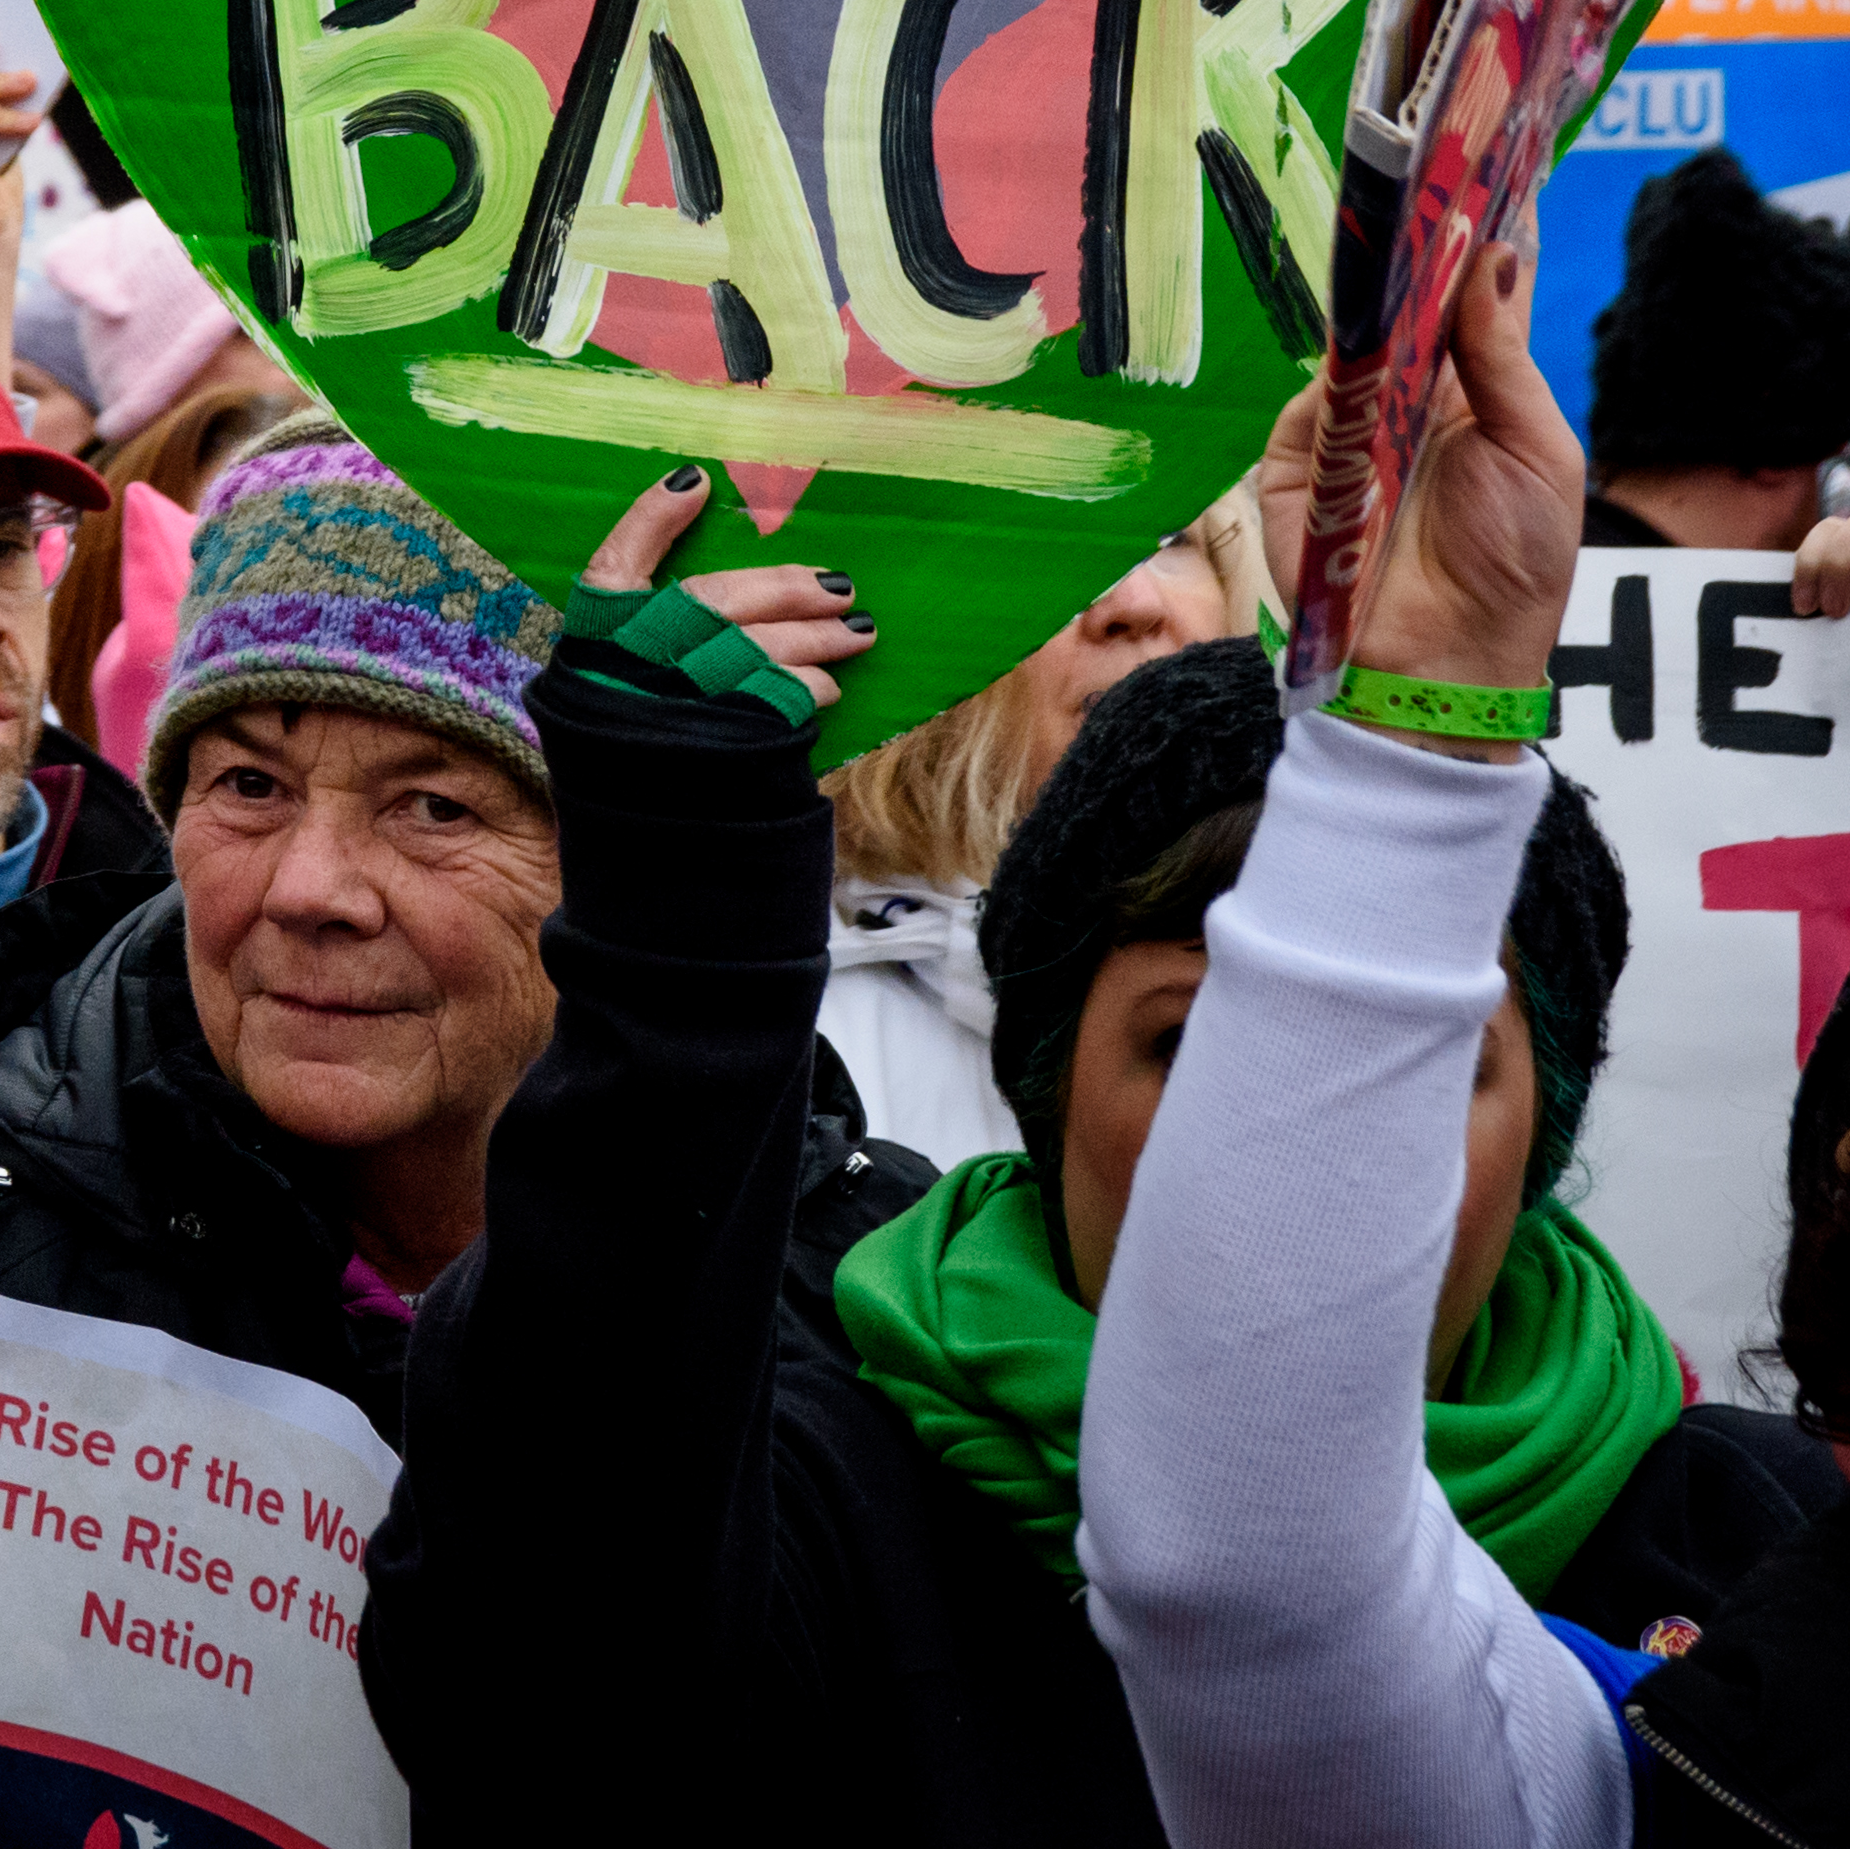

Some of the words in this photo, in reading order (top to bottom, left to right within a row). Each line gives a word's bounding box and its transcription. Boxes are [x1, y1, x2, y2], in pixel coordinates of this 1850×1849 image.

[135, 1440, 193, 1490] of
[206, 1457, 286, 1524] the
[122, 1516, 235, 1596] Rise
[250, 1574, 299, 1624] of
[81, 1590, 255, 1696] Nation
